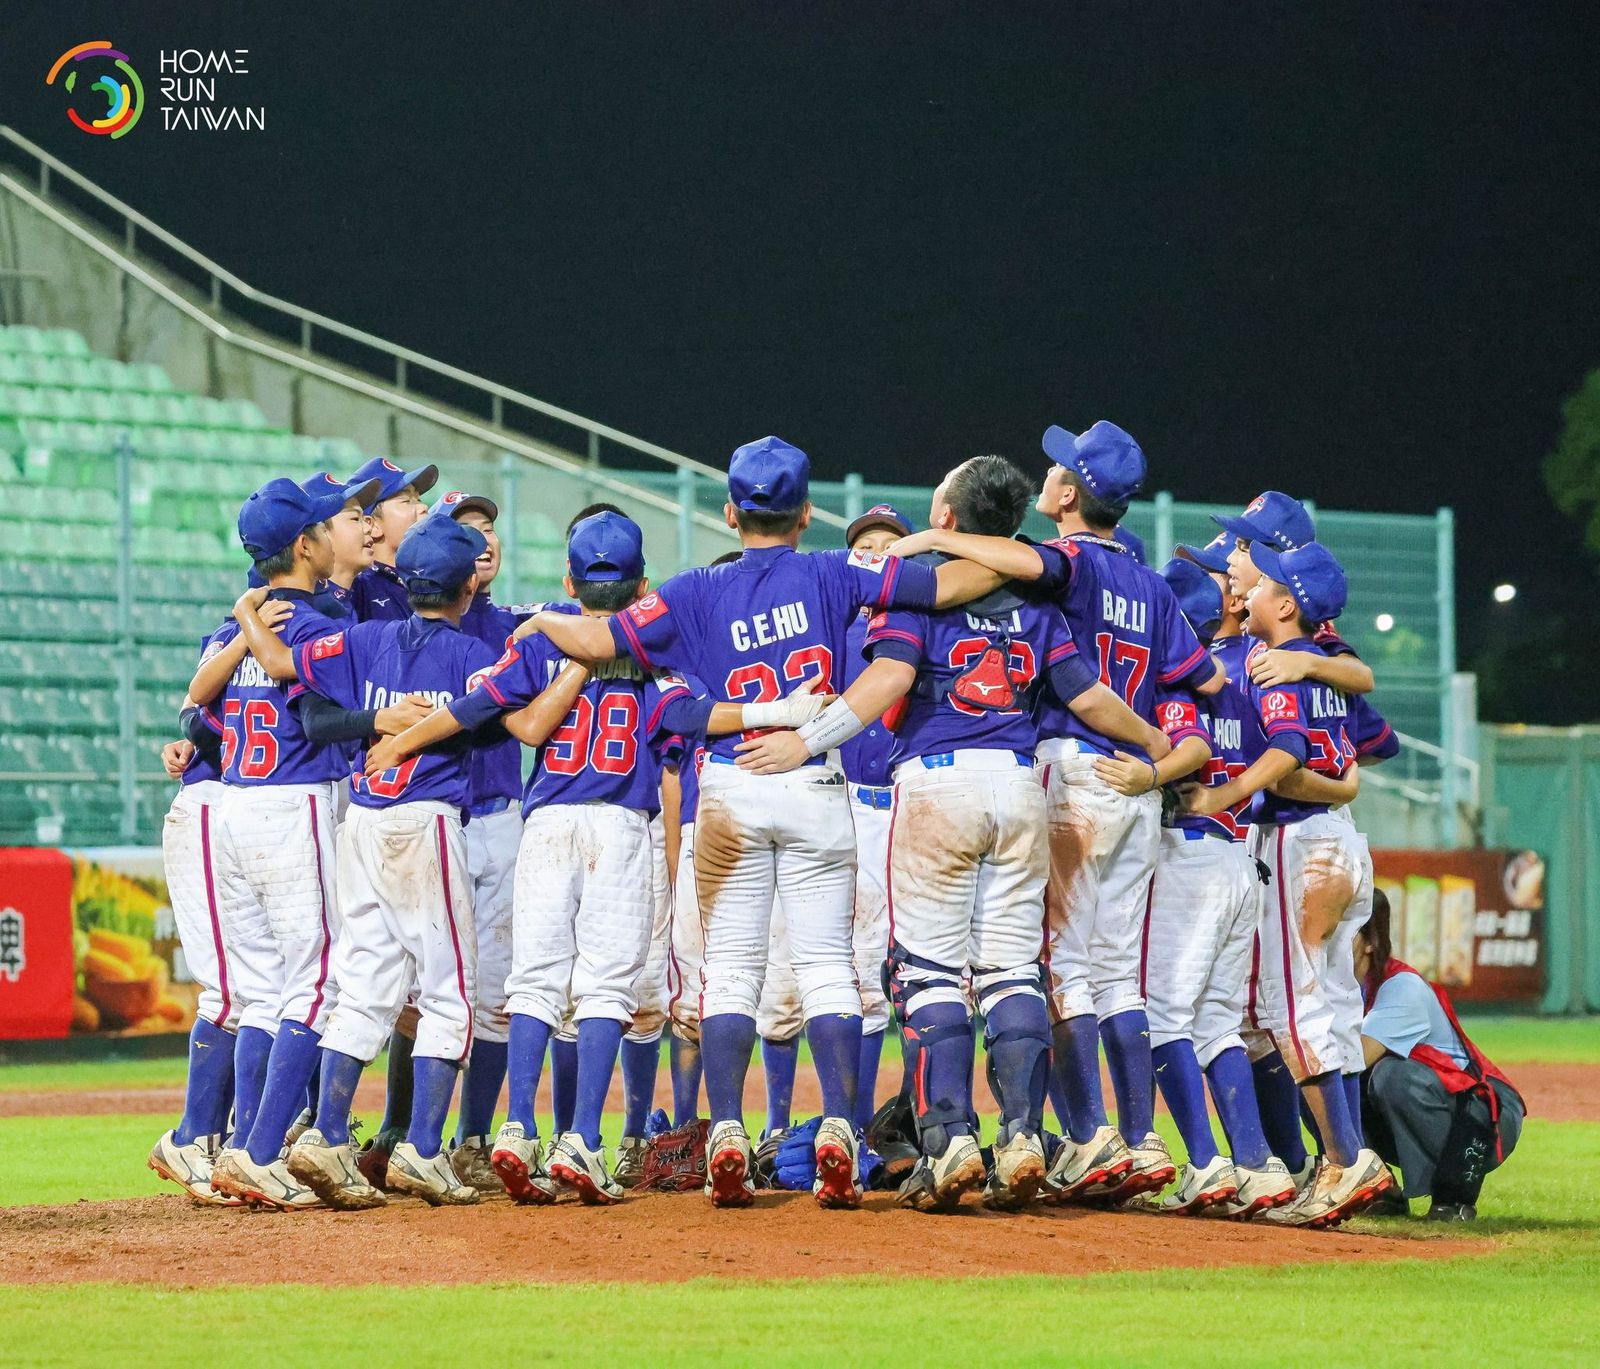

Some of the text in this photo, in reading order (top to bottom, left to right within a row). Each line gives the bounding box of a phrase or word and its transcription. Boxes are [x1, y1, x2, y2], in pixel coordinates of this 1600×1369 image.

[730, 601, 809, 652] C.E.HU
[1096, 632, 1150, 711] 17
[543, 692, 640, 777] 98
